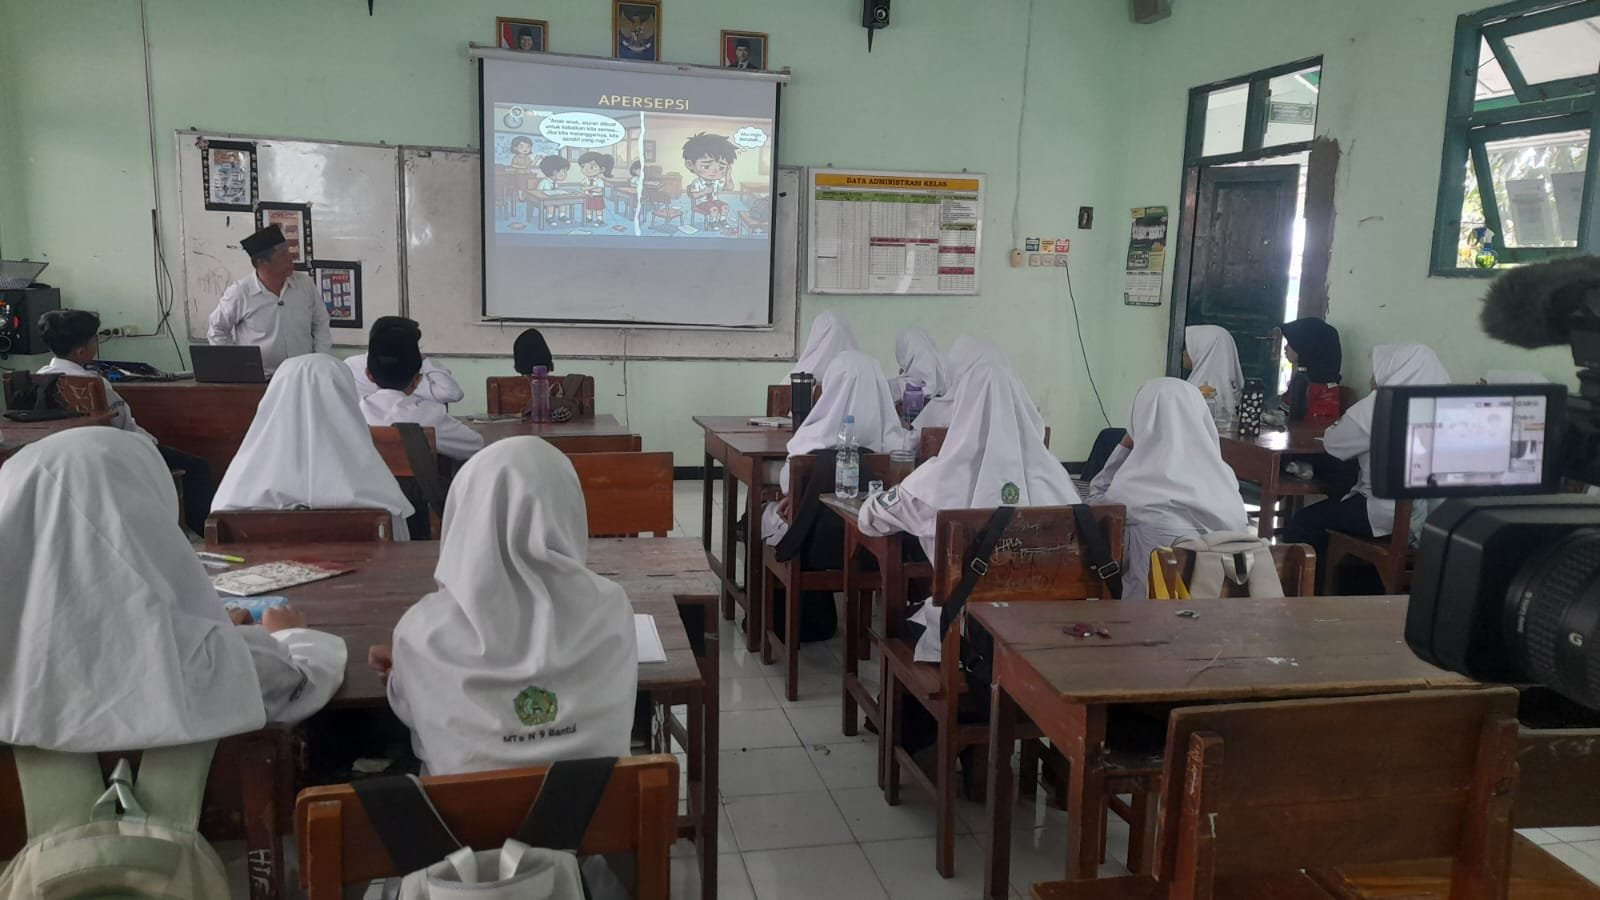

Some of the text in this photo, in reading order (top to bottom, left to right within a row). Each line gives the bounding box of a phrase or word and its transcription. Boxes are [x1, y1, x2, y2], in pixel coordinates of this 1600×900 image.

[598, 94, 689, 110] APERSEPSI
[846, 177, 948, 188] DATA ADMINISTRASI KELAS
